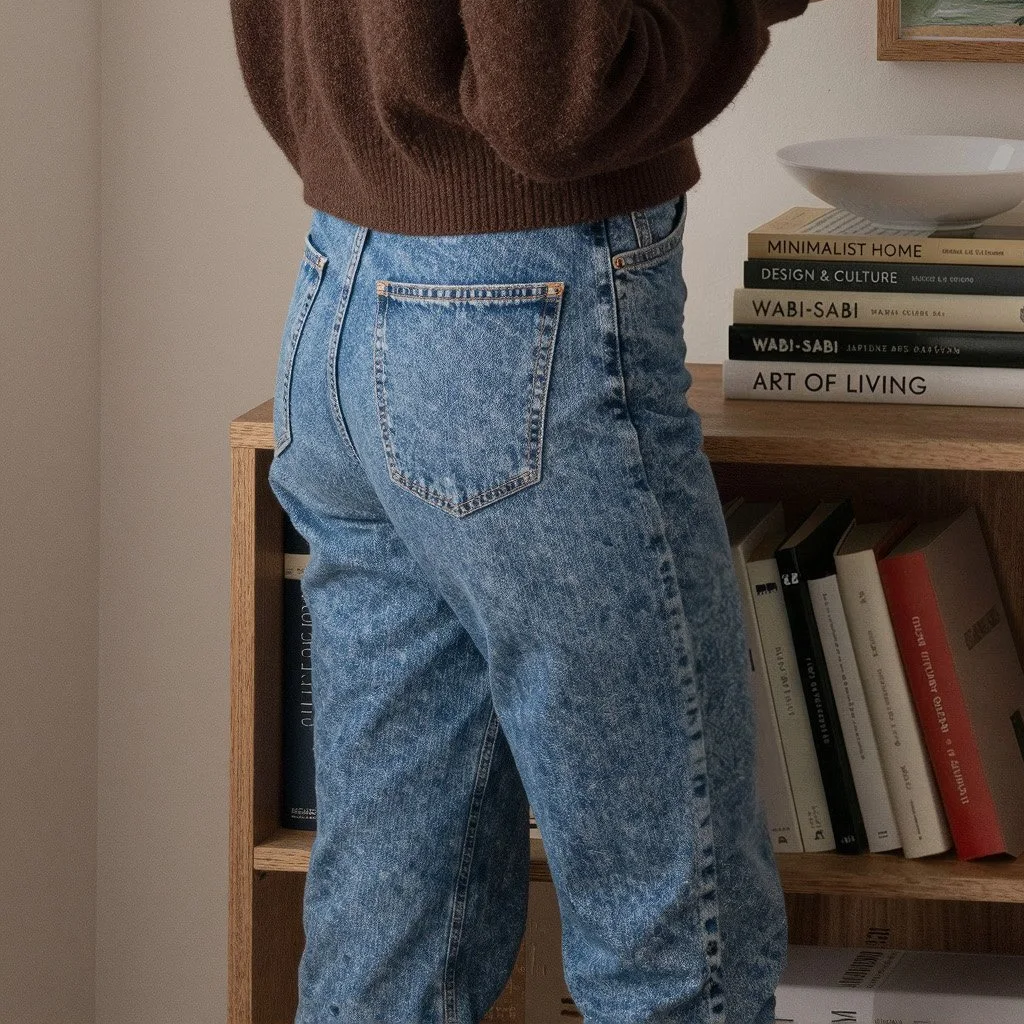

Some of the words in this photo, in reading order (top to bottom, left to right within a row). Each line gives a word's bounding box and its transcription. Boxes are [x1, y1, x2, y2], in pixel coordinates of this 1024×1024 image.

[767, 240, 867, 256] MINIMALIST
[872, 243, 922, 258] HOME
[761, 268, 815, 282] DESIGN
[820, 270, 830, 282] &
[834, 270, 898, 284] CULTURE
[752, 300, 858, 318] WABI-SABI
[752, 337, 838, 354] WABI-SABI
[752, 371, 796, 391] ART
[805, 373, 837, 392] OF
[847, 374, 927, 396] LIVING
